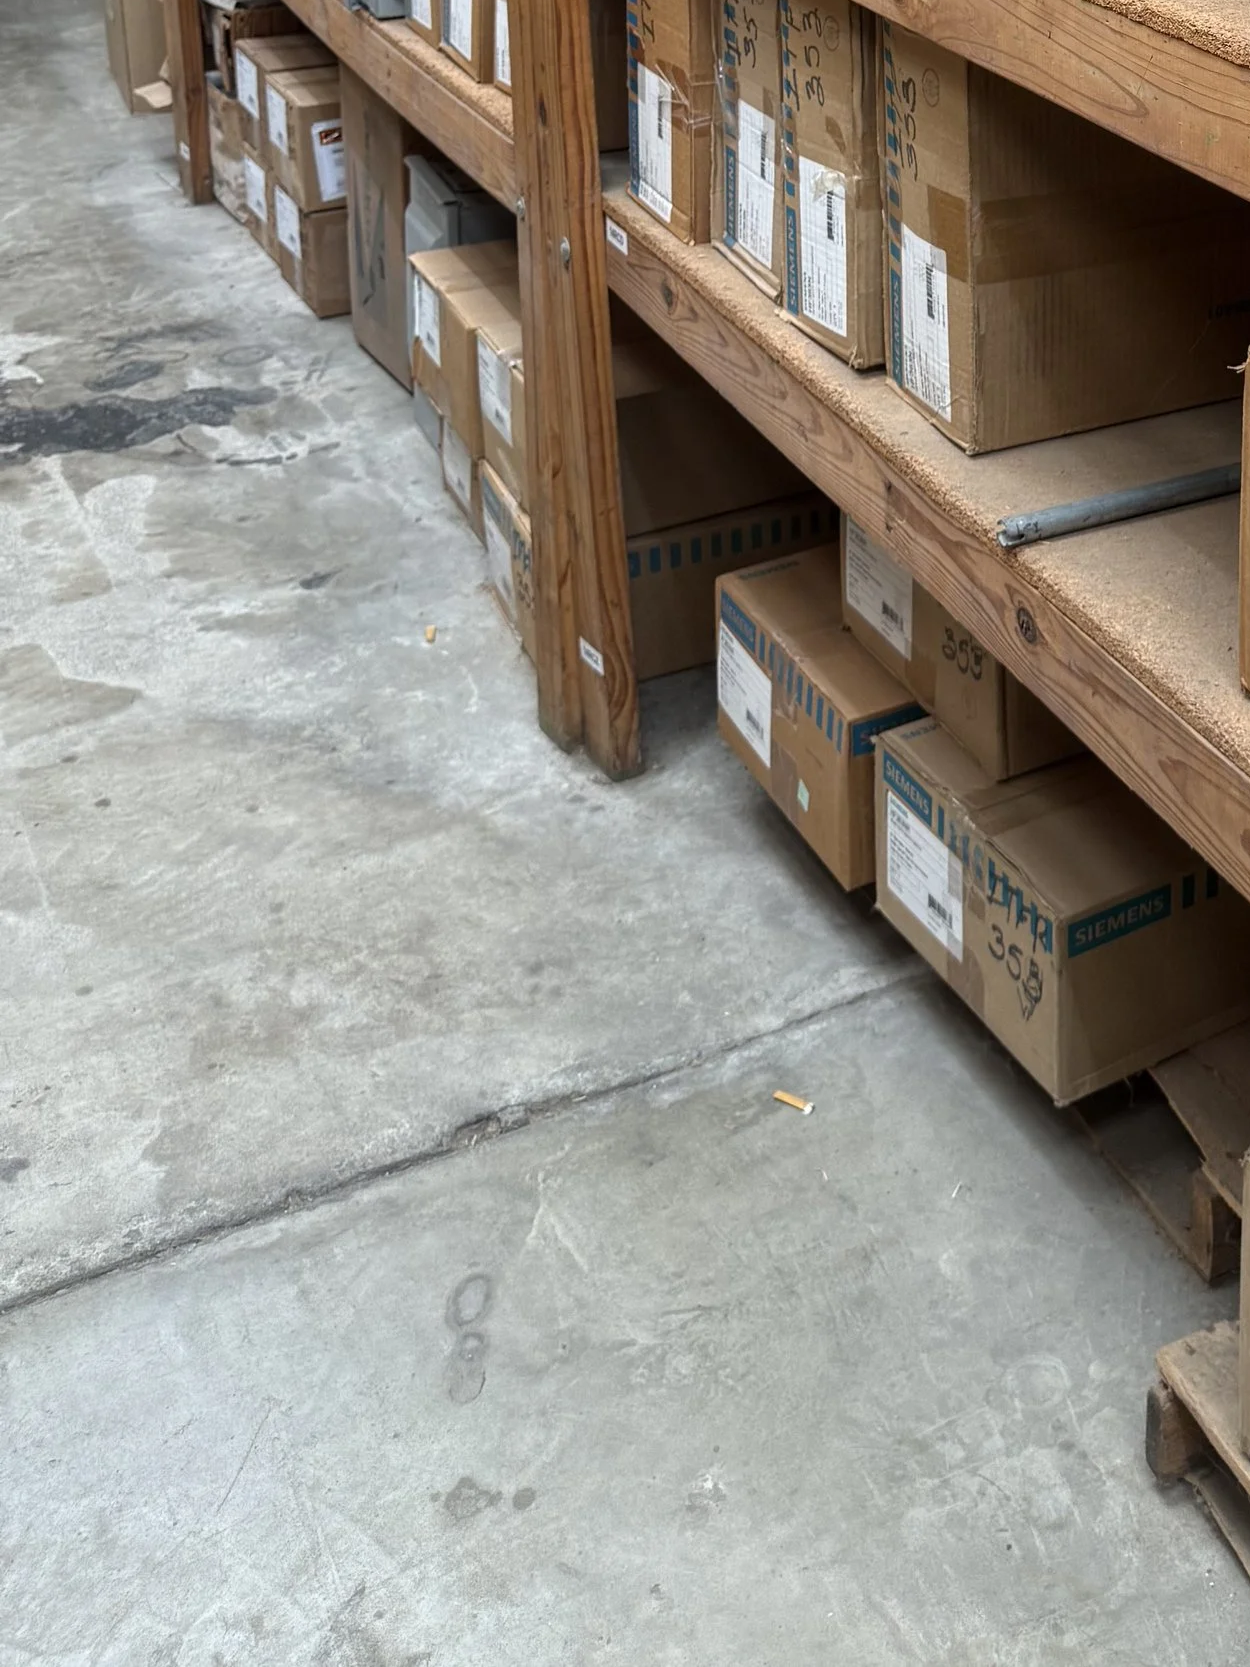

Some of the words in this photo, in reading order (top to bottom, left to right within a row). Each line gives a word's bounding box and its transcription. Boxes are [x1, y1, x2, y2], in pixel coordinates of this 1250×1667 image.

[803, 7, 825, 108] 353
[901, 76, 918, 182] 353
[787, 213, 797, 310] SIEMENS
[892, 279, 901, 378] SIEMENS
[886, 760, 930, 815] SIEMENS
[1075, 893, 1165, 947] SIEMENS
